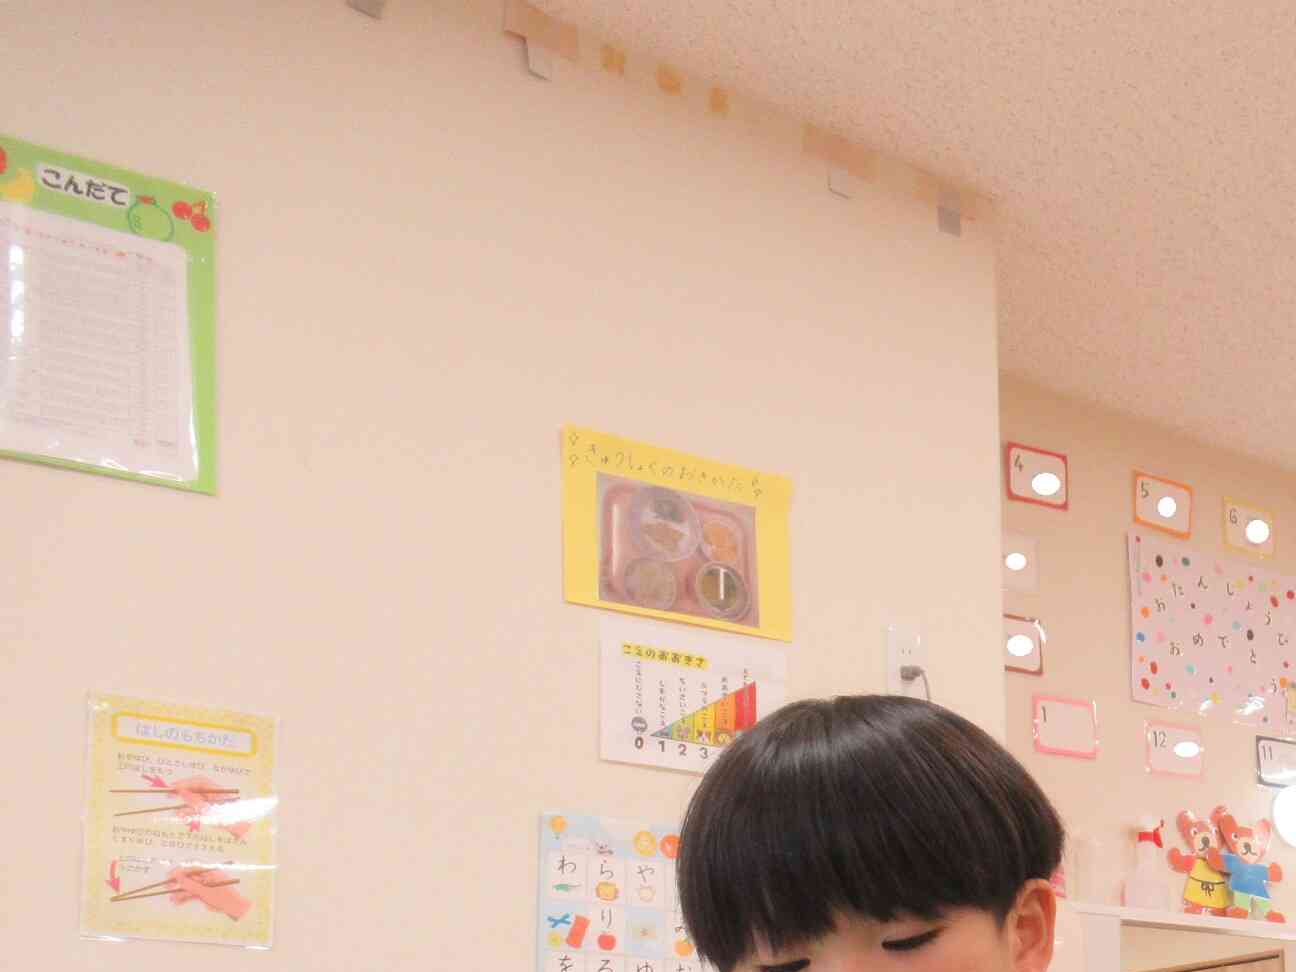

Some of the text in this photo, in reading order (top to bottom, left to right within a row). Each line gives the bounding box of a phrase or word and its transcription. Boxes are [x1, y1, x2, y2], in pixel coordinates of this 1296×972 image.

[42, 168, 128, 206] こんだて
[1013, 455, 1024, 472] 4
[1141, 482, 1150, 498] 5
[1229, 507, 1238, 524] 6
[623, 643, 706, 669] こえのおおきさ
[1041, 705, 1048, 723] 1
[634, 736, 710, 760] 0 1 2 3
[1152, 730, 1168, 748] 12
[1261, 744, 1274, 762] 11
[557, 855, 577, 874] わ
[599, 859, 614, 880] ら
[636, 864, 656, 882] や
[600, 909, 613, 928] り
